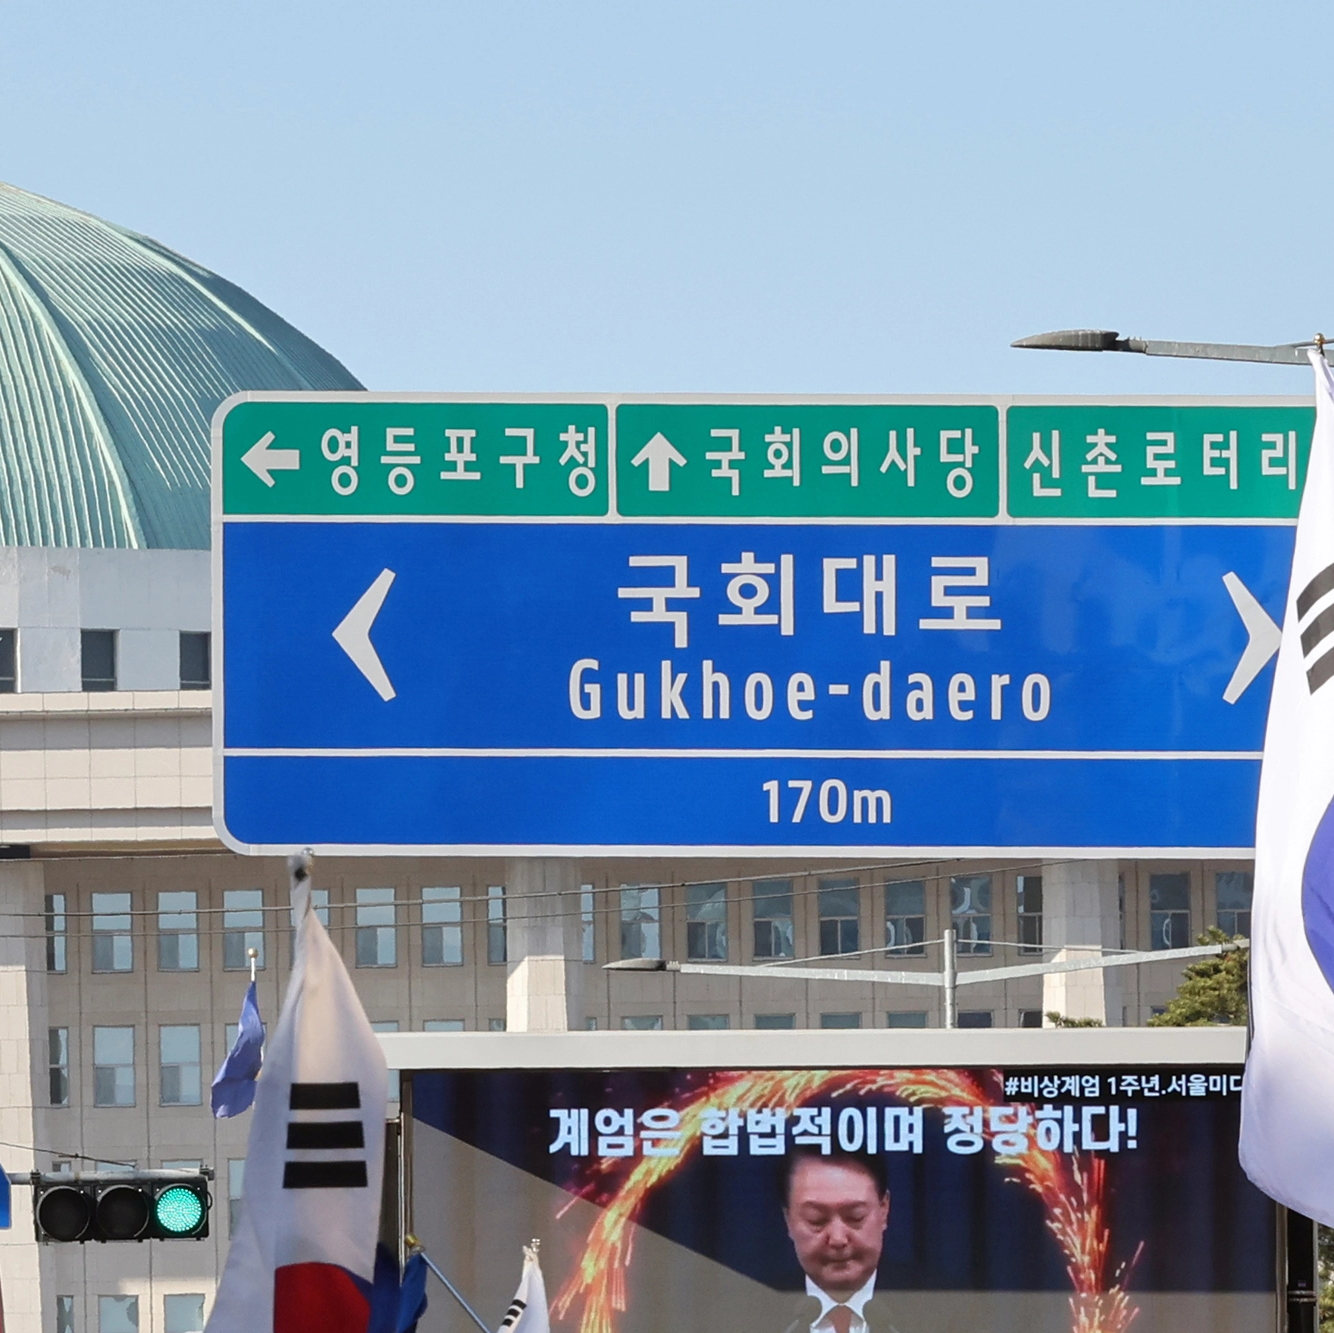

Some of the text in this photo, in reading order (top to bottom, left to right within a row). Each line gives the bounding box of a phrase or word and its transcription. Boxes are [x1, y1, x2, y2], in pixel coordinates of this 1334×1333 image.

[320, 425, 599, 499] 영등포구청
[706, 425, 980, 499] 국회의사당
[1023, 427, 1299, 499] 신촌로터리
[616, 551, 1003, 648] 국회대로
[569, 657, 1052, 723] Gukhoe-daero
[763, 779, 892, 826] 170m
[1005, 1075, 1100, 1097] #비상계엄
[548, 1104, 1138, 1158] 계엄은 합법적이며 정당하다!
